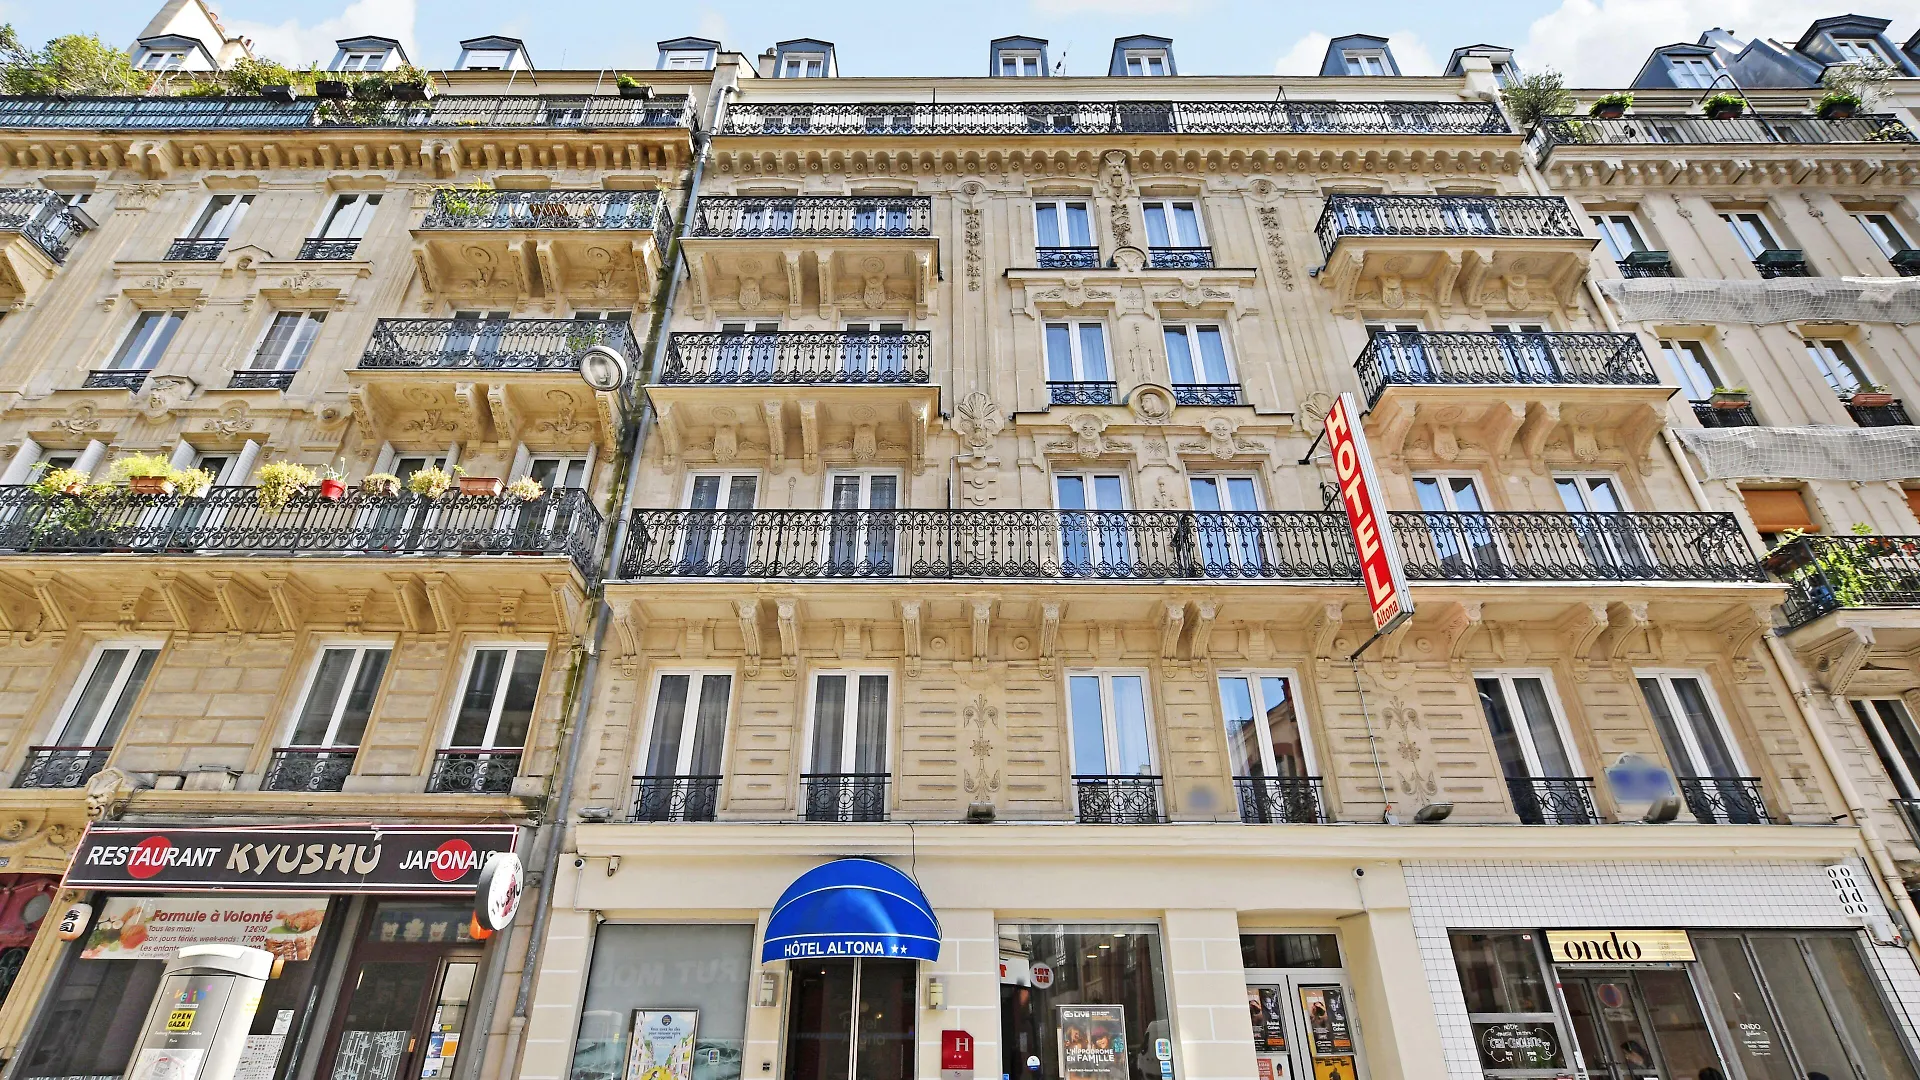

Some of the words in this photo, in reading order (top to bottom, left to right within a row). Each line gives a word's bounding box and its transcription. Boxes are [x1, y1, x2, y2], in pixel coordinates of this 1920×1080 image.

[1326, 402, 1391, 606] HOTEL
[1376, 600, 1399, 629] Altona
[85, 845, 221, 867] RESTAURANT
[152, 909, 207, 923] Formule
[210, 909, 220, 923] à
[223, 909, 274, 923] Volonté
[784, 941, 824, 957] HÔTEL
[827, 941, 884, 955] ALTONA
[1563, 931, 1642, 961] ondo
[168, 1020, 185, 1028] GAZA
[955, 1037, 969, 1052] H
[1077, 1054, 1115, 1066] FAMILLE
